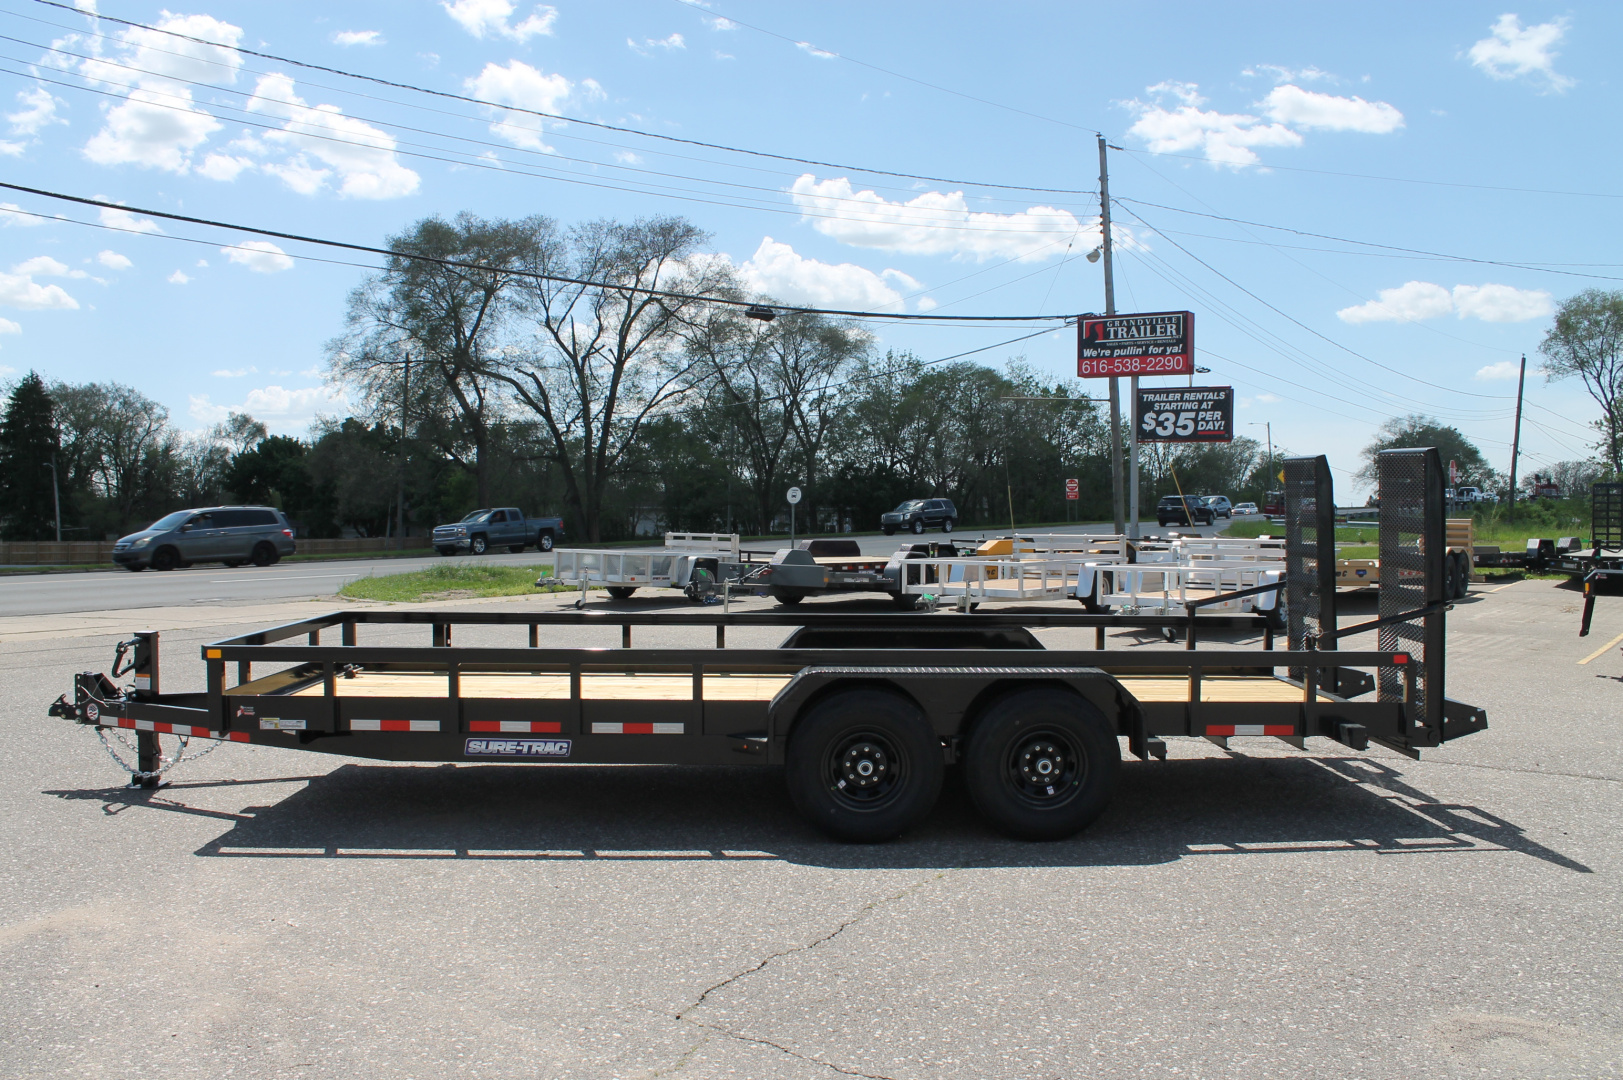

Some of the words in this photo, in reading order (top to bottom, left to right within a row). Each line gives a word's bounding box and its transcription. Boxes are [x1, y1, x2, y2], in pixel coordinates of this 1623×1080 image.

[1107, 317, 1178, 327] GRANDVILLE
[1107, 324, 1177, 339] TRAILER
[1083, 347, 1111, 357] We're
[1113, 345, 1146, 357] pullin'
[1148, 345, 1164, 354] for
[1166, 344, 1183, 355] ya!
[1082, 356, 1183, 374] 616-538-2290
[1143, 393, 1181, 401] TRAILER
[1183, 392, 1226, 400] RENTALS
[1154, 402, 1198, 410] STARTING
[1201, 401, 1214, 409] AT
[1142, 411, 1196, 436] $35
[1198, 411, 1222, 420] PER
[1197, 421, 1225, 430] DAY!
[467, 741, 568, 755] SURE-TRAC
